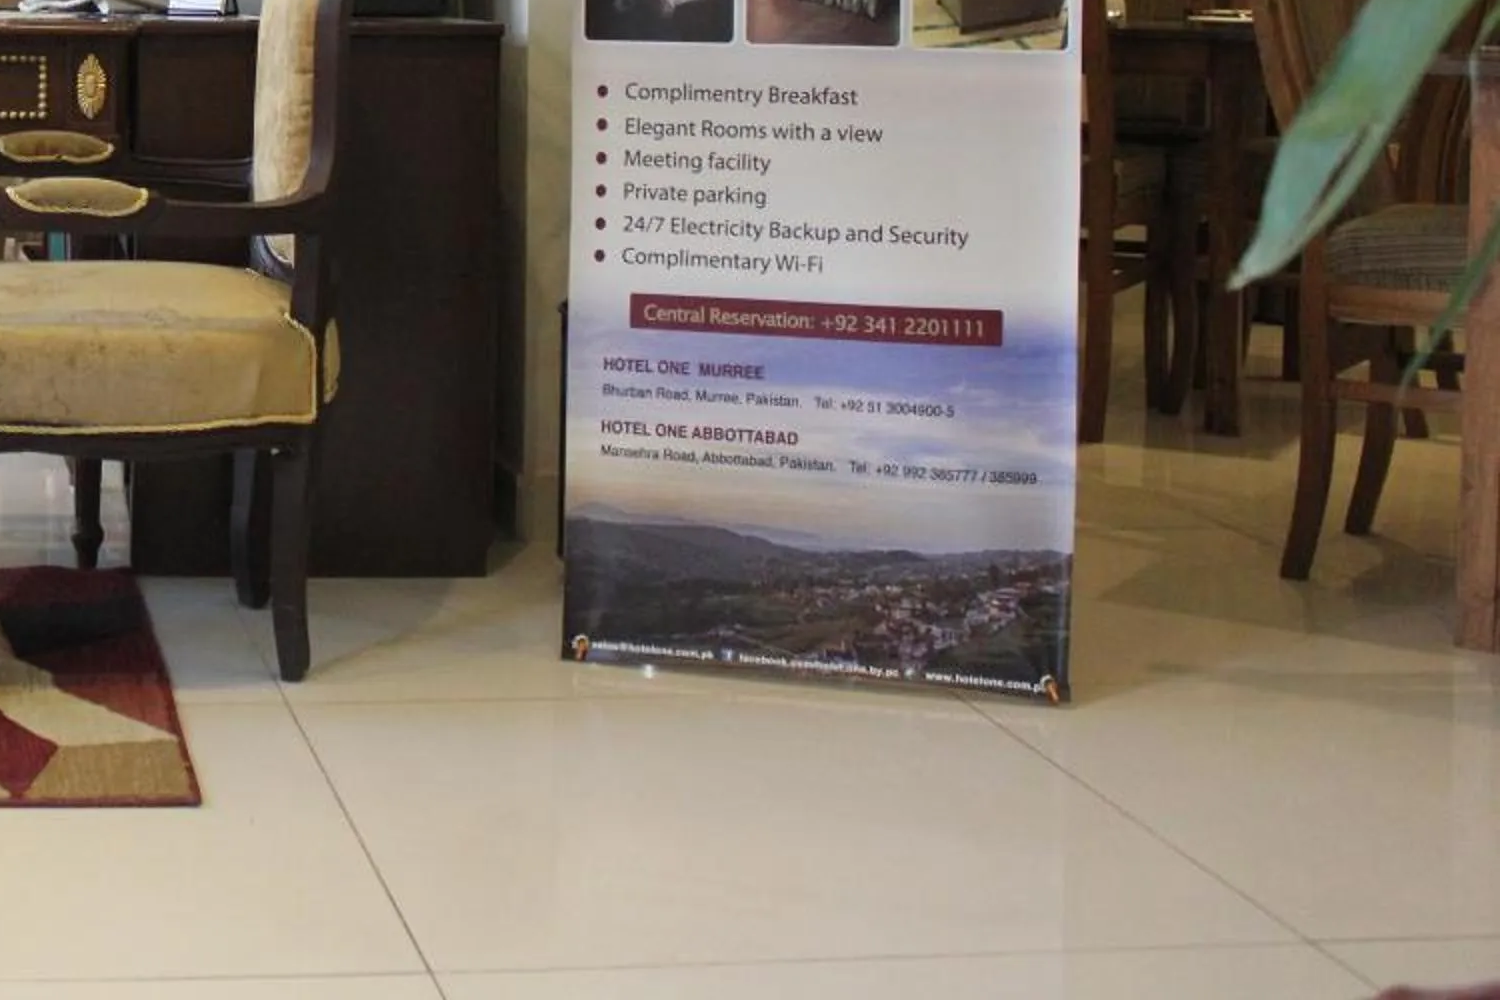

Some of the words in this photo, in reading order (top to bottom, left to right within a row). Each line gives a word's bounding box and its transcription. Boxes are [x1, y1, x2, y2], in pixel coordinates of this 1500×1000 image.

[624, 82, 763, 107] Complimentry
[768, 86, 860, 106] Breakfast
[624, 116, 696, 140] Elegant
[701, 119, 767, 140] Rooms
[772, 122, 815, 141] with
[820, 127, 832, 141] a
[837, 124, 884, 143] view
[623, 150, 703, 174] Meeting
[707, 151, 772, 176] facility
[623, 182, 688, 202] Private
[693, 186, 768, 209] parking
[622, 215, 665, 234] 24/7
[670, 216, 764, 241] Electricity
[768, 221, 841, 245] Backup
[844, 224, 883, 244] and
[887, 225, 970, 250] Security
[621, 247, 771, 275] Complimentary
[776, 253, 824, 274] Wi-Fi
[643, 304, 705, 324] Central
[709, 307, 815, 330] Reservation:
[820, 314, 857, 333] +92
[863, 315, 896, 335] 341
[904, 316, 984, 338] 2201111
[602, 357, 653, 373] HOTEL
[657, 360, 690, 376] ONE
[697, 362, 766, 380] MURREE
[600, 419, 651, 437] HOTEL
[655, 423, 688, 439] ONE
[691, 425, 799, 446] ABBOTTABAD
